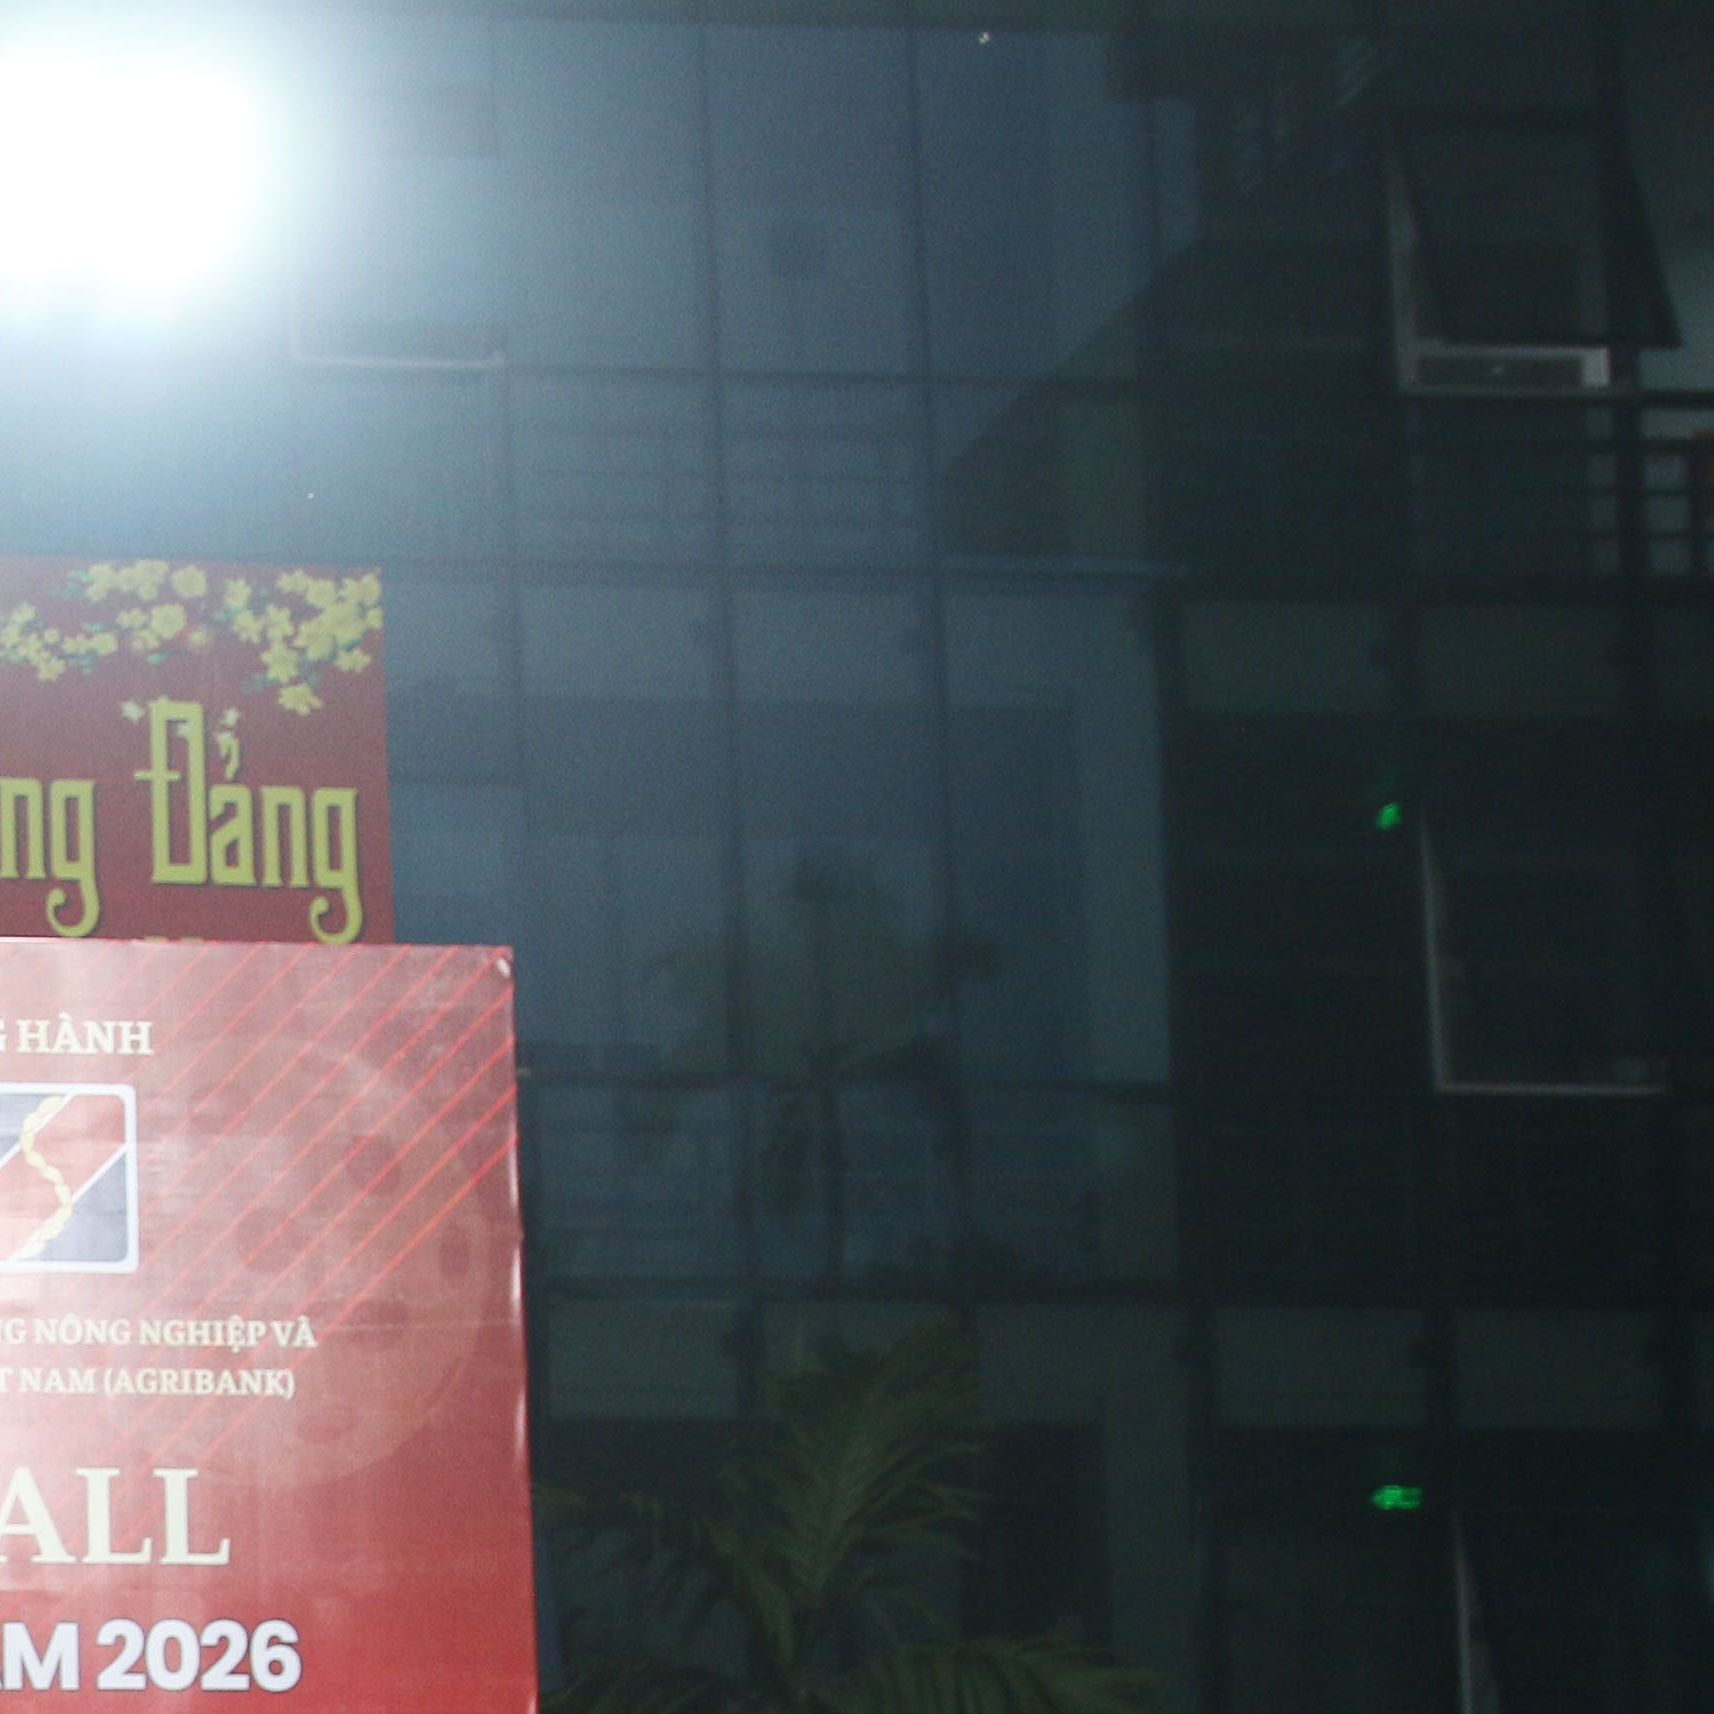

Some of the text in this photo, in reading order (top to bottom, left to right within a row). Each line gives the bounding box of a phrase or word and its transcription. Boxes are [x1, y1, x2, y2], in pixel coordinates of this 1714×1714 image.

[134, 700, 363, 945] Đảng
[15, 1011, 154, 1056] HÀNH
[34, 1314, 132, 1347] NÔNG
[138, 1314, 267, 1353] NGHIỆP
[272, 1315, 318, 1348] VÀ
[19, 1366, 97, 1394] NAM
[103, 1366, 297, 1400] (AGRIBANK)
[95, 1618, 302, 1693] 2026
